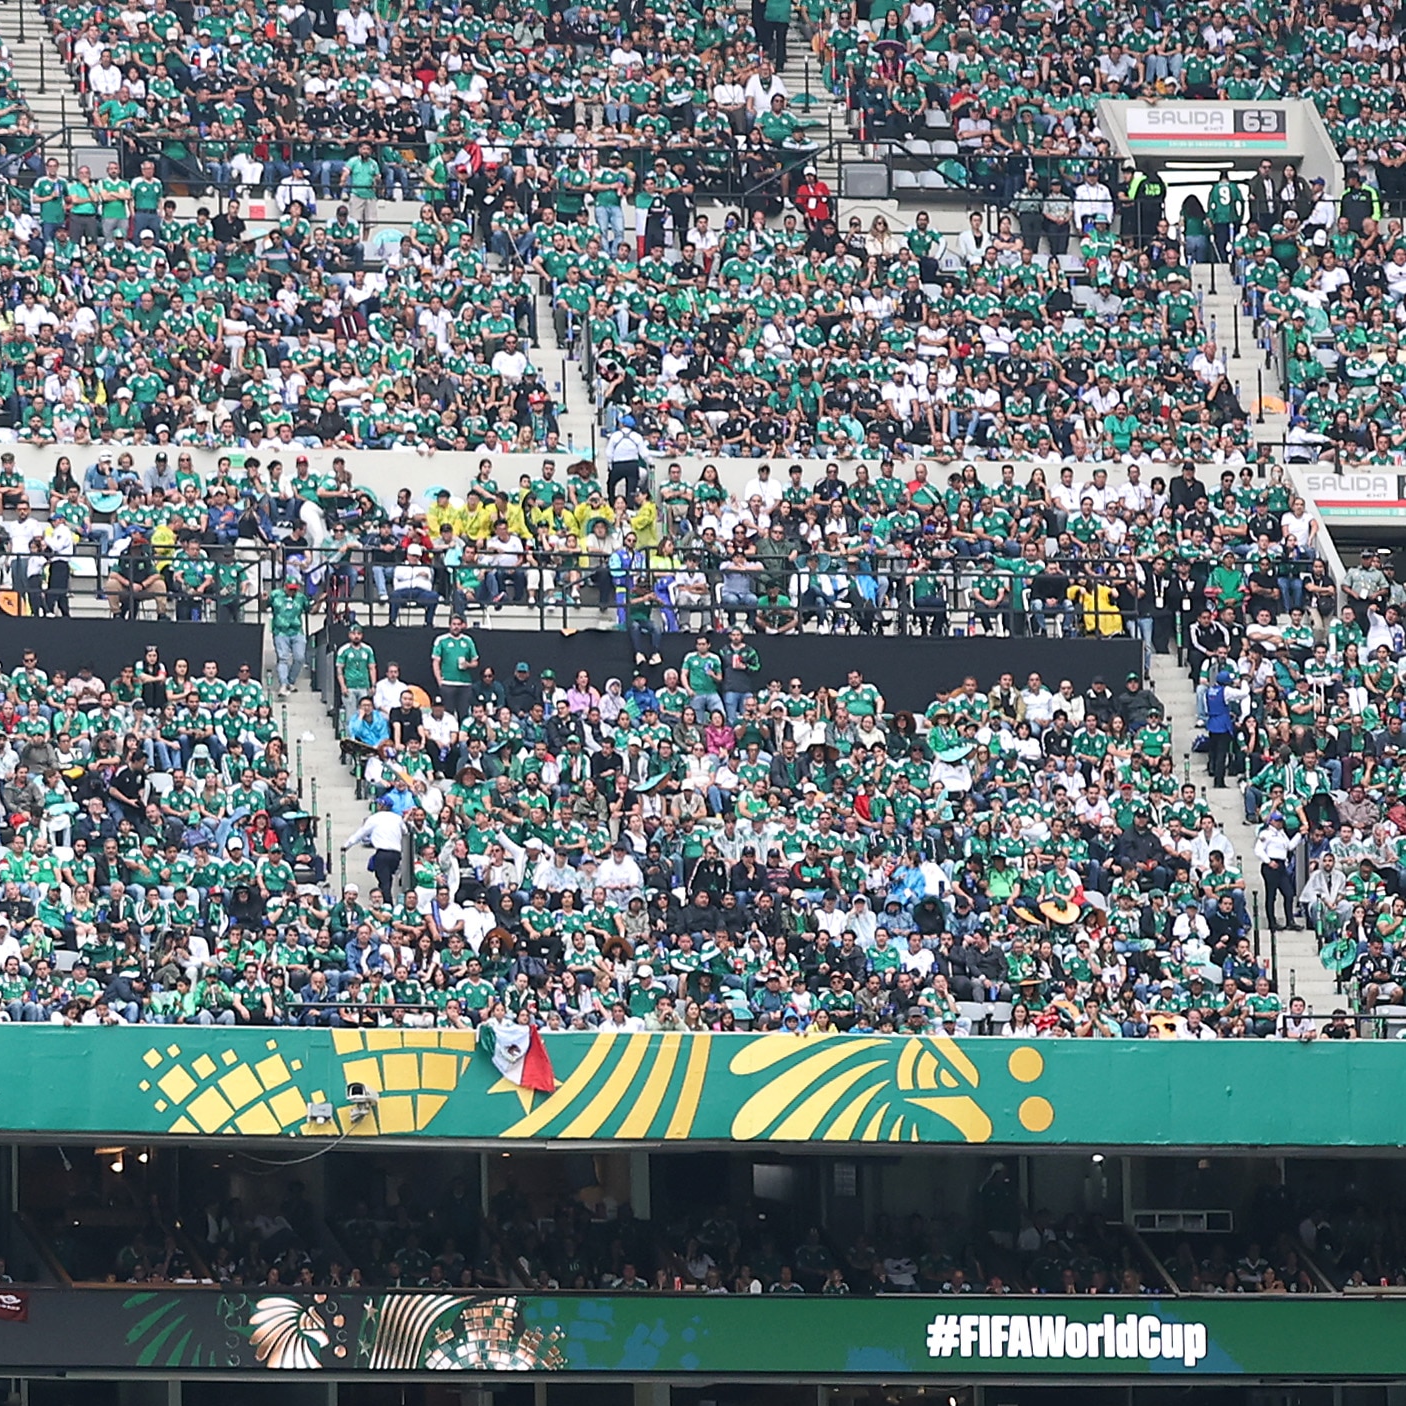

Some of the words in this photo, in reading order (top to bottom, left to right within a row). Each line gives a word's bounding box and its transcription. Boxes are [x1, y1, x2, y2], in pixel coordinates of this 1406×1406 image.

[1146, 110, 1224, 125] SALIDA
[1242, 110, 1278, 133] 63
[1219, 185, 1232, 206] 9
[1307, 476, 1388, 491] SALIDA
[926, 1314, 1207, 1367] #FIFAWorldCup
